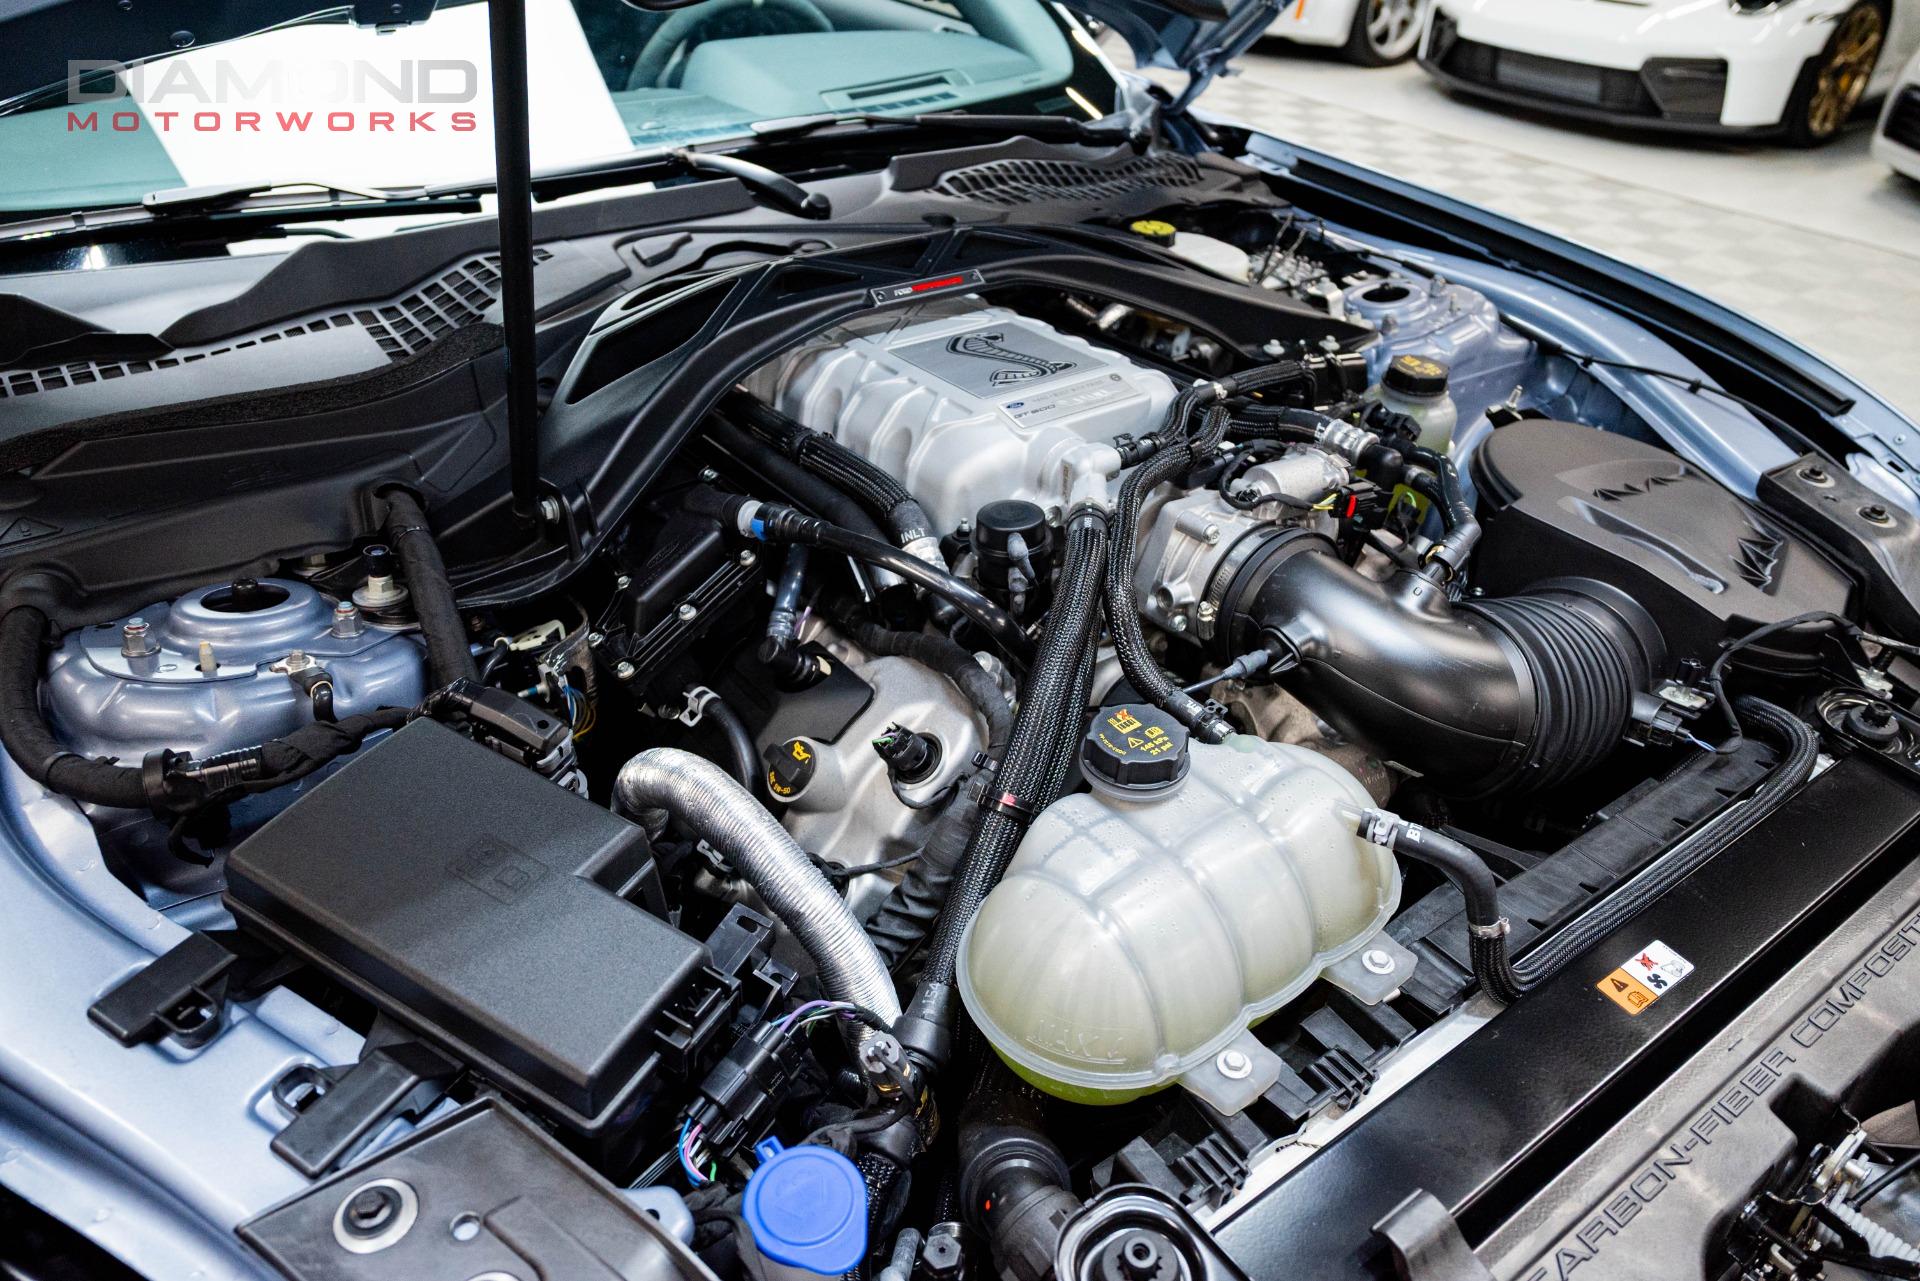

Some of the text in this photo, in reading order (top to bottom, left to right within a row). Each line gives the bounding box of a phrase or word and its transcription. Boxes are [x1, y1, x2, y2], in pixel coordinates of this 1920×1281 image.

[901, 527, 927, 544] INLT
[1526, 908, 1920, 1281] ARBON-FIBER COMPOSIT
